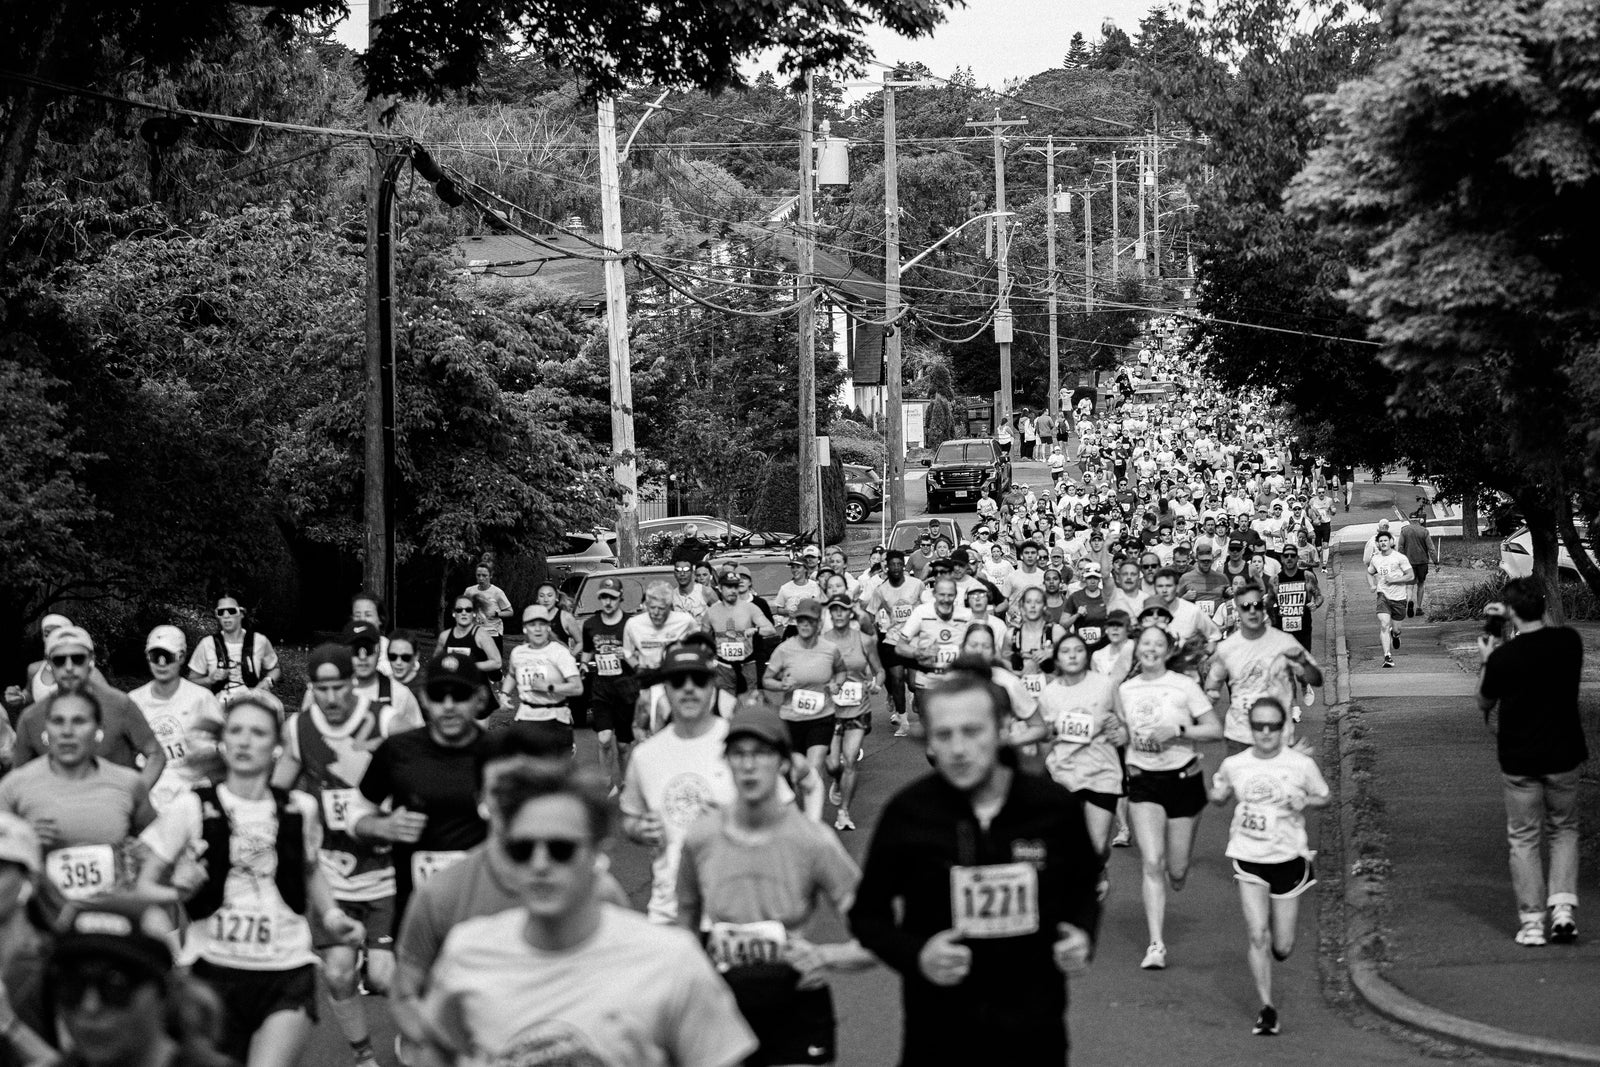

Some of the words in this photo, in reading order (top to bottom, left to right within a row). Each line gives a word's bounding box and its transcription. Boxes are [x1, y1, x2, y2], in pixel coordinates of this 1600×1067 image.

[1279, 593, 1305, 605] OUTTA
[894, 608, 912, 618] 1050
[1279, 606, 1304, 616] CEDAR
[723, 647, 743, 657] 1829
[598, 660, 620, 670] 1113
[798, 699, 817, 710] 667
[1241, 812, 1267, 831] 263
[61, 861, 102, 889] 395
[963, 884, 1027, 920] 1271
[213, 914, 271, 944] 1276
